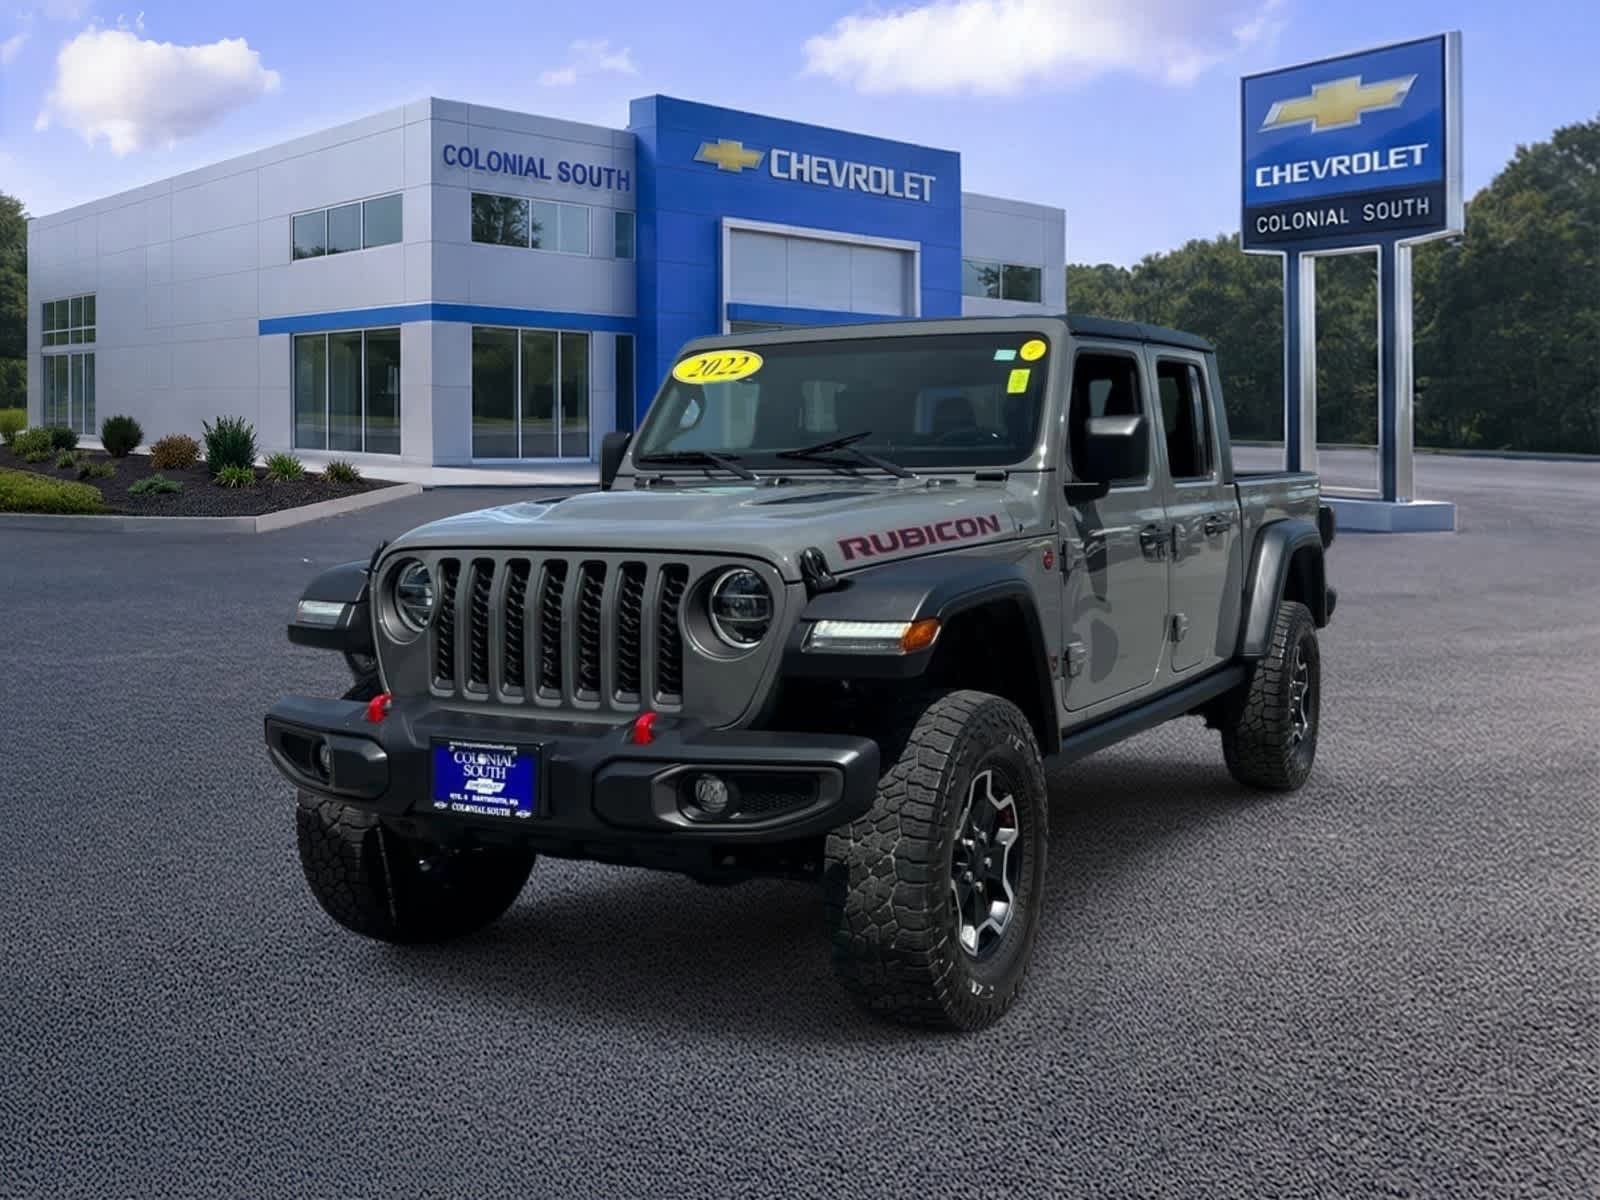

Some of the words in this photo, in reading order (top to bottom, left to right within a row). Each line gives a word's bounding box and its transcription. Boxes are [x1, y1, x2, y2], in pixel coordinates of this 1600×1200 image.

[442, 143, 552, 181] COLONIAL
[557, 160, 631, 192] SOUTH
[769, 147, 937, 202] CHEVROLET
[1255, 142, 1429, 188] CHEVROLET
[1256, 207, 1350, 234] COLONIAL
[1363, 197, 1430, 222] SOUTH
[687, 355, 751, 378] 2022
[837, 513, 1001, 562] RUBICON
[453, 751, 515, 767] COLONIAL
[463, 764, 506, 779] SOUTH
